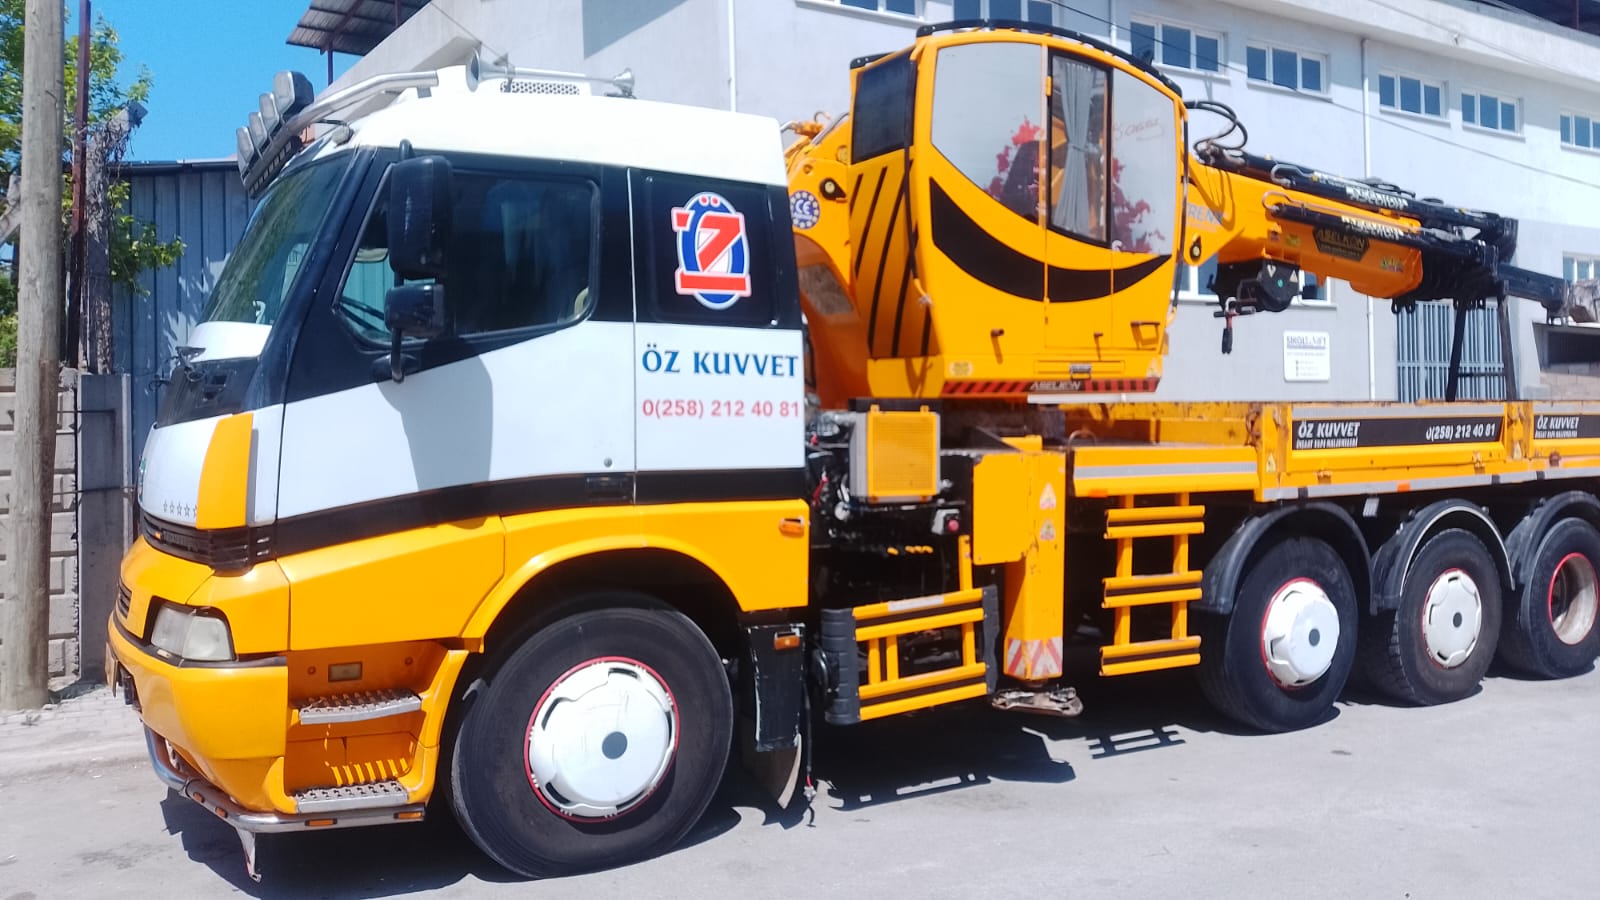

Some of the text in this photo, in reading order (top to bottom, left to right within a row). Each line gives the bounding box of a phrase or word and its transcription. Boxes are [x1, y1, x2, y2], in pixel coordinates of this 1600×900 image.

[642, 343, 799, 377] ÖZ KUVVET
[642, 399, 799, 419] 0(258) 212 40 81
[1298, 419, 1314, 438] ÖZ
[1316, 421, 1360, 438] KUVVET
[1454, 424, 1472, 438] 212
[1472, 423, 1484, 437] 40
[1550, 416, 1580, 430] KUVVET
